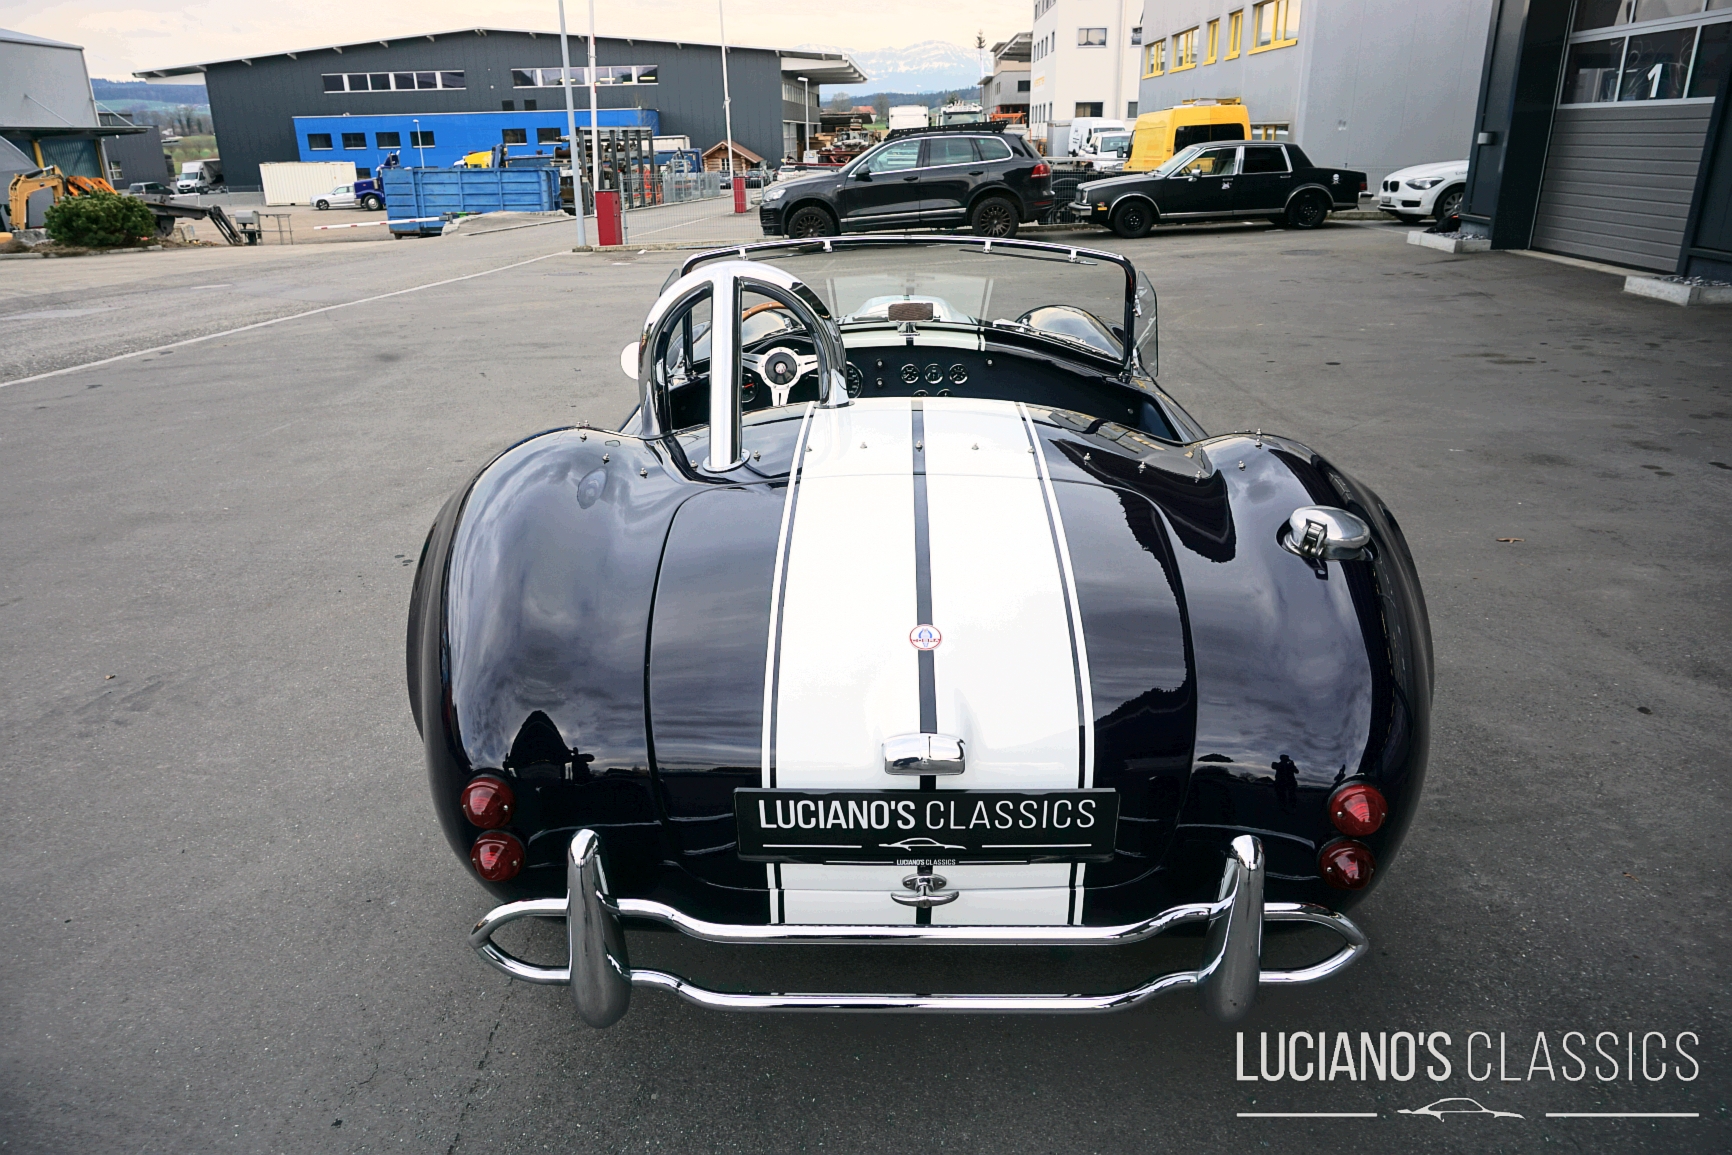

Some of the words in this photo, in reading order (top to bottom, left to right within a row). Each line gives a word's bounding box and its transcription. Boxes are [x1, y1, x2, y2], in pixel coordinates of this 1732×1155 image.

[1647, 63, 1663, 98] 1
[758, 799, 916, 830] LUCIANO'S
[925, 799, 1097, 830] CLASSICS
